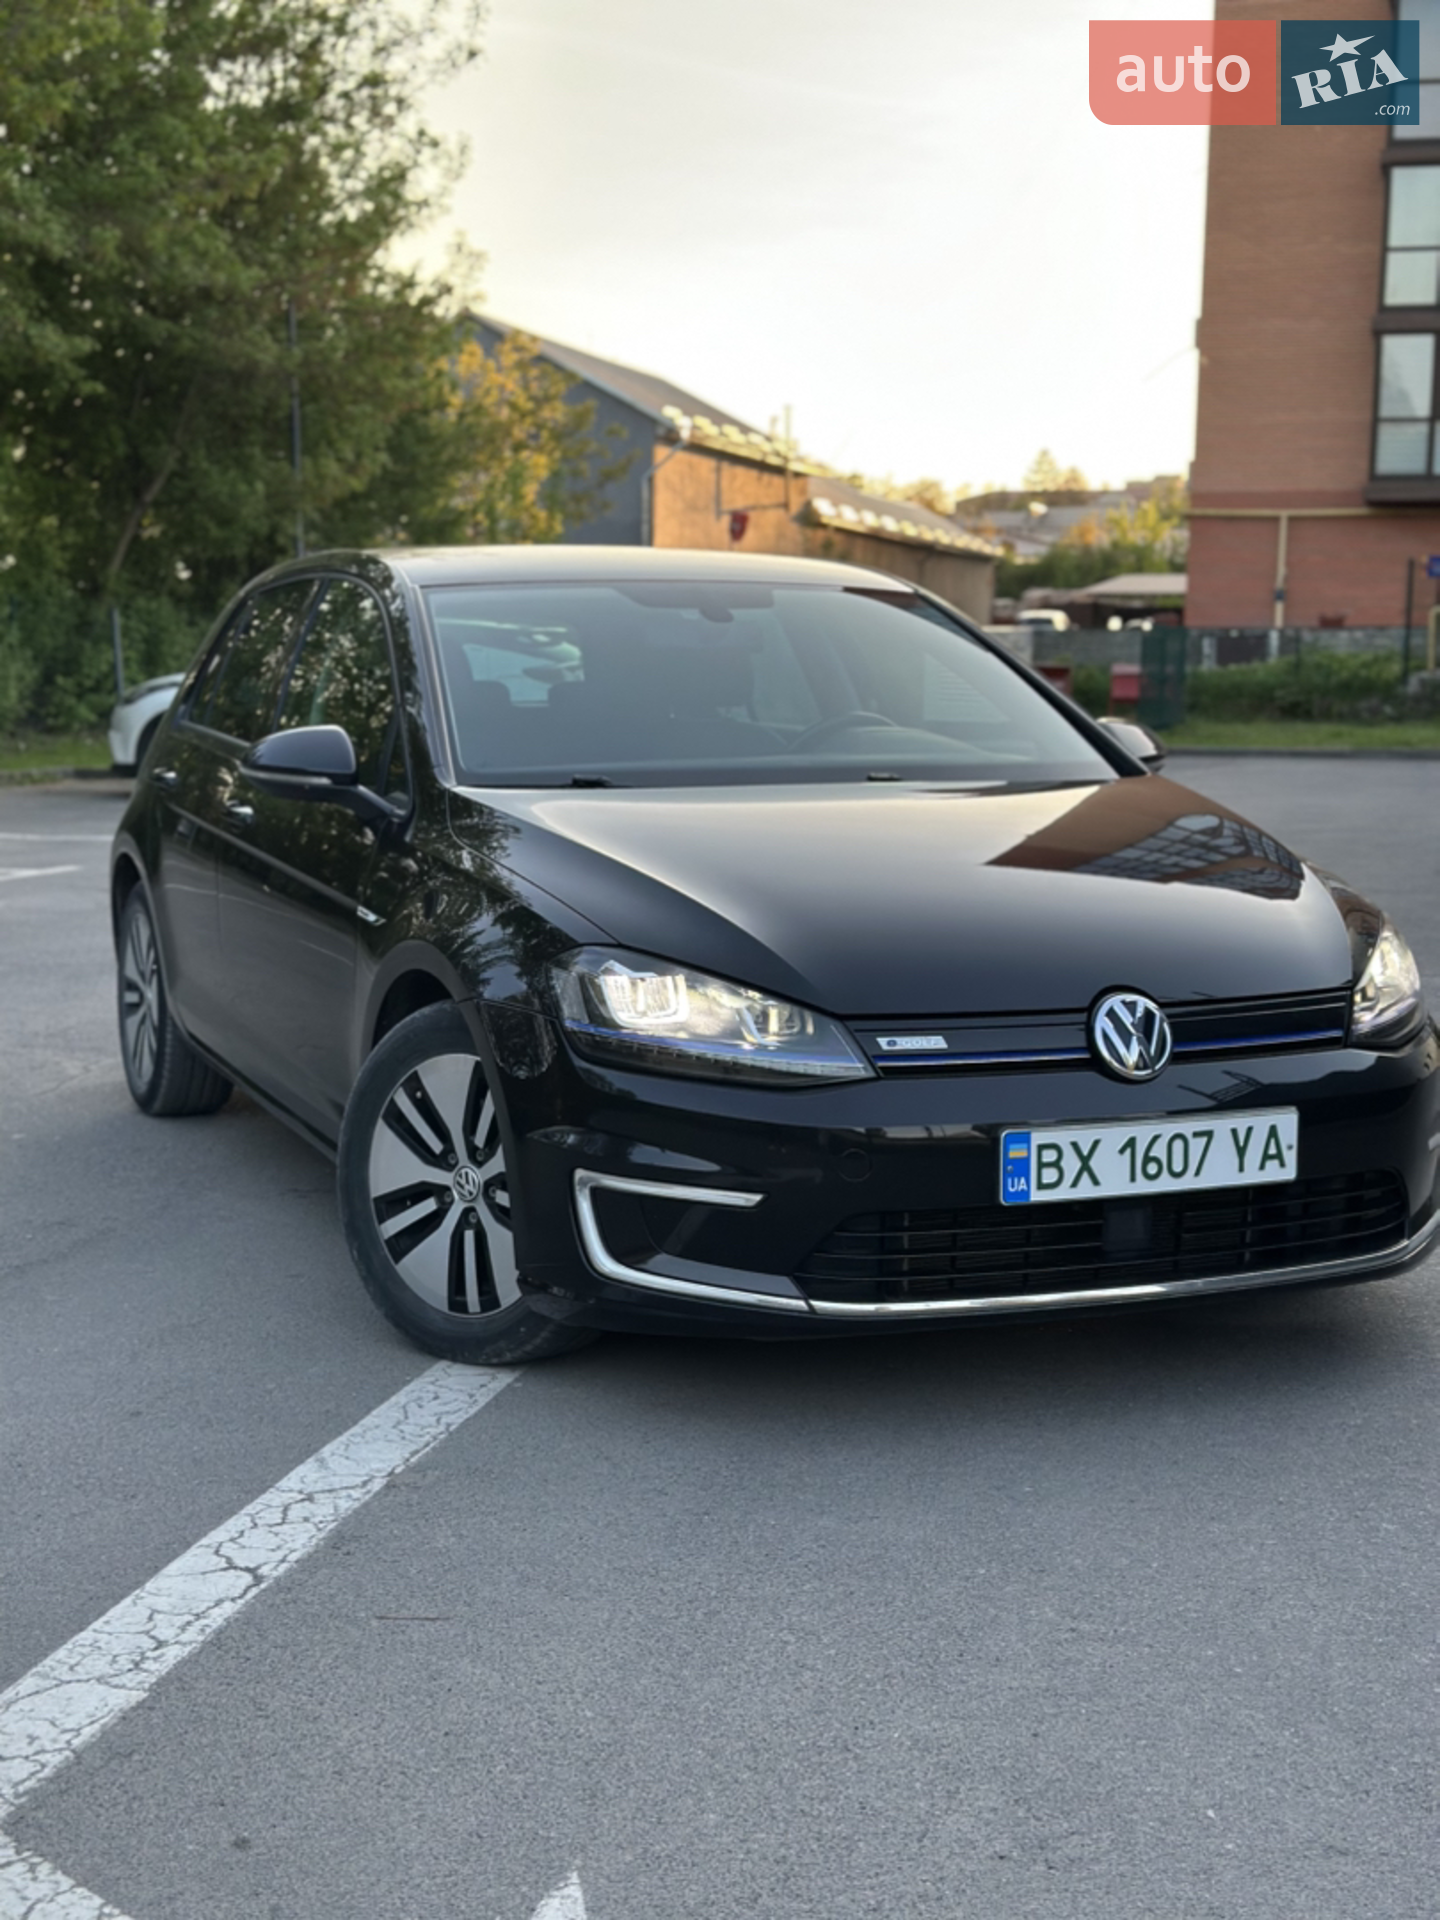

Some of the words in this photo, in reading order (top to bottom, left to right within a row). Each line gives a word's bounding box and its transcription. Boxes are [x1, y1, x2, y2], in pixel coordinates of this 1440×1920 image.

[1036, 1138, 1102, 1191] BX
[1117, 1129, 1215, 1183] 1607
[1230, 1124, 1287, 1173] YA
[1007, 1177, 1028, 1192] UA
